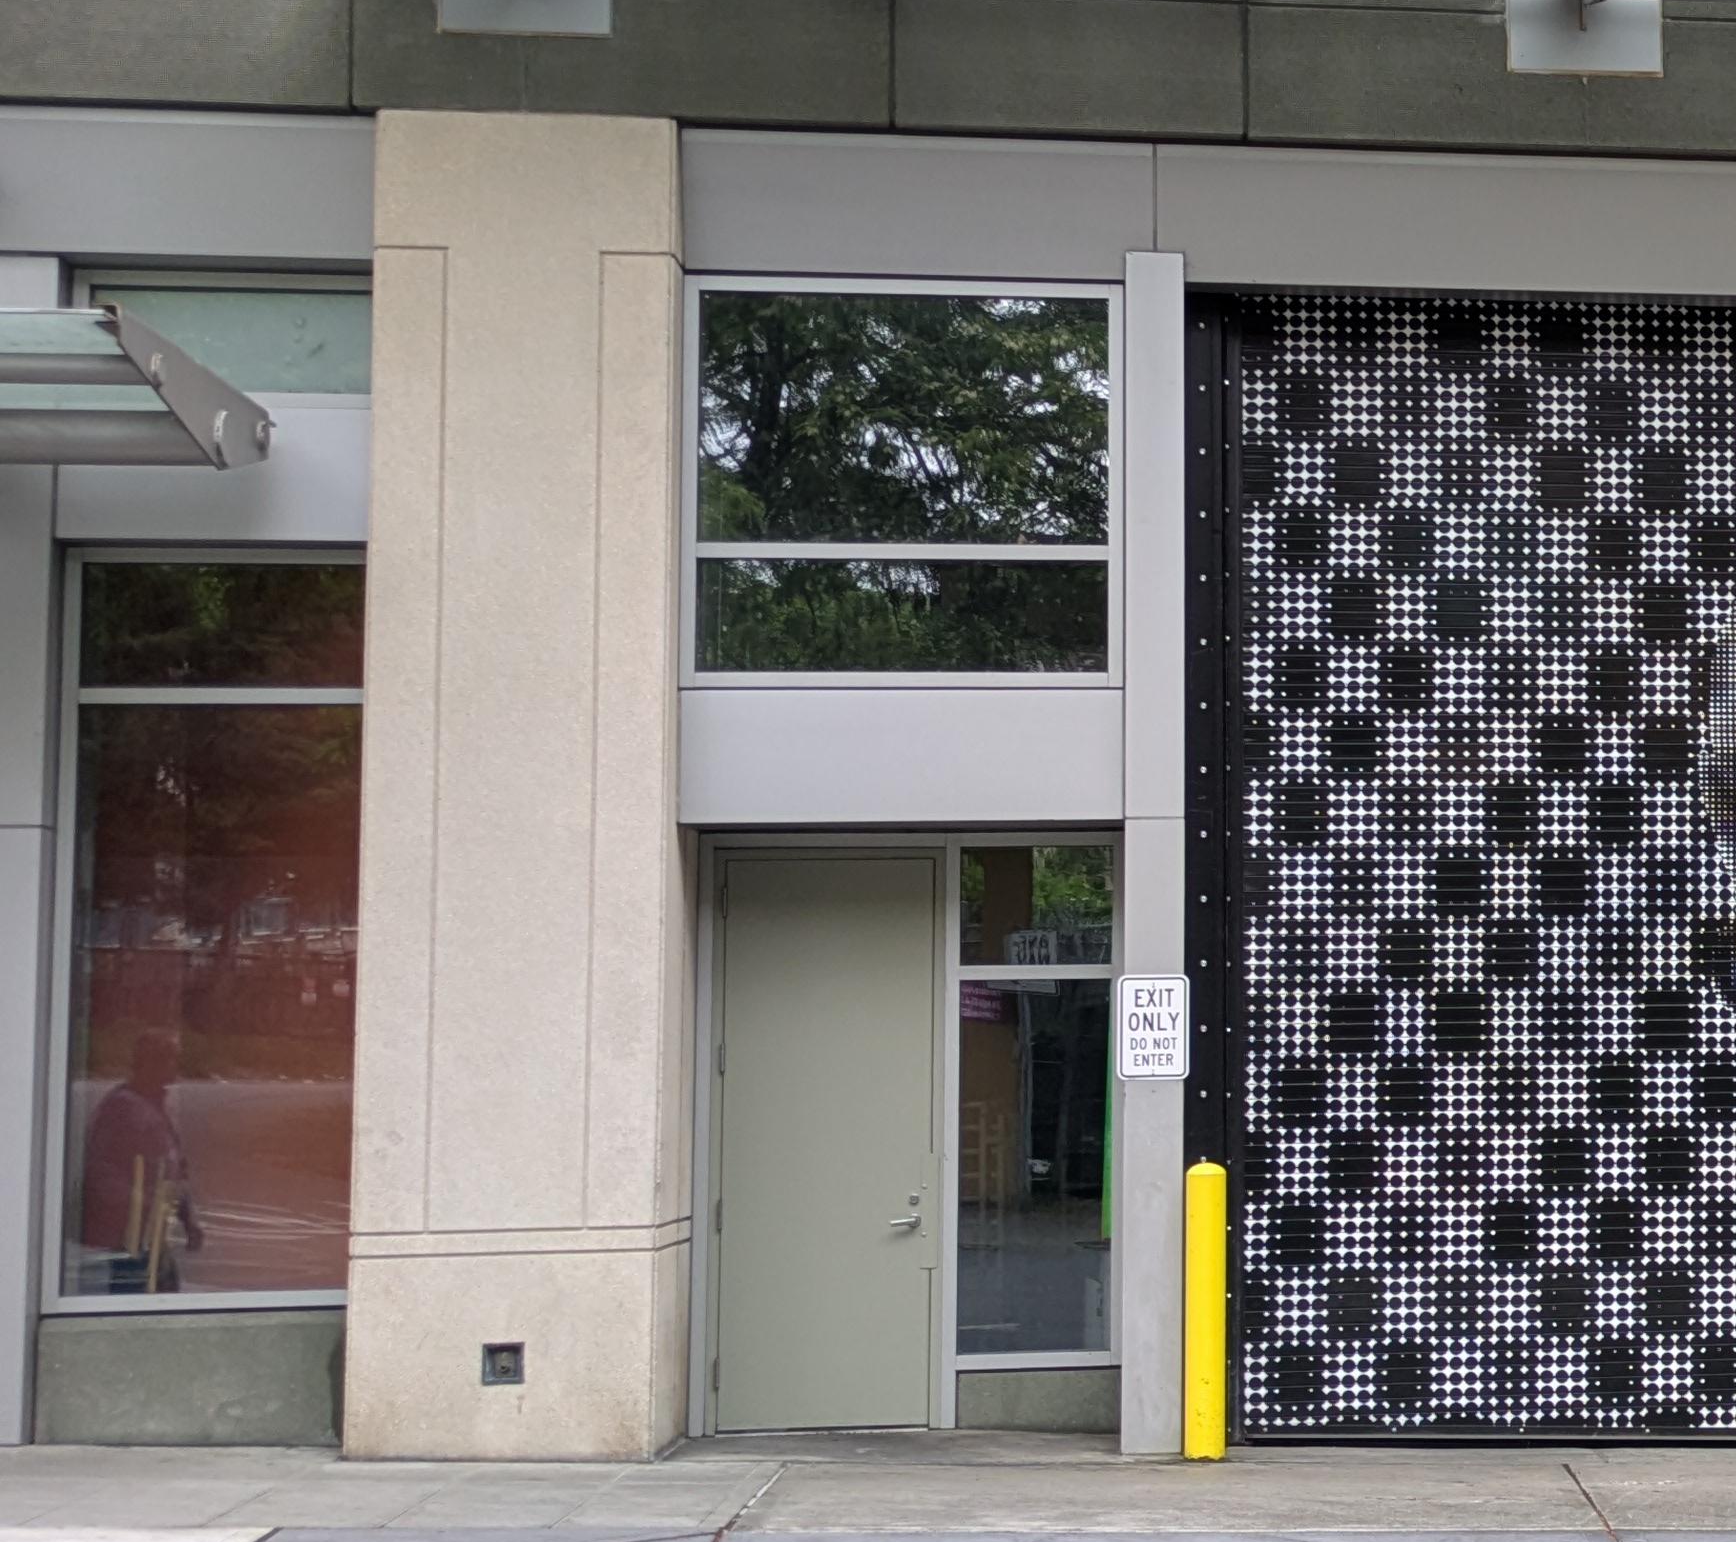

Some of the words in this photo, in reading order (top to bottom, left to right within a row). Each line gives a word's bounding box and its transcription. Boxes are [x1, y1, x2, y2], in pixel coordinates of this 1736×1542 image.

[1134, 989, 1175, 1008] EXIT
[1128, 1012, 1180, 1032] ONLY
[1130, 1038, 1147, 1050] DO
[1153, 1037, 1178, 1050] NOT
[1133, 1054, 1174, 1067] ENTER
